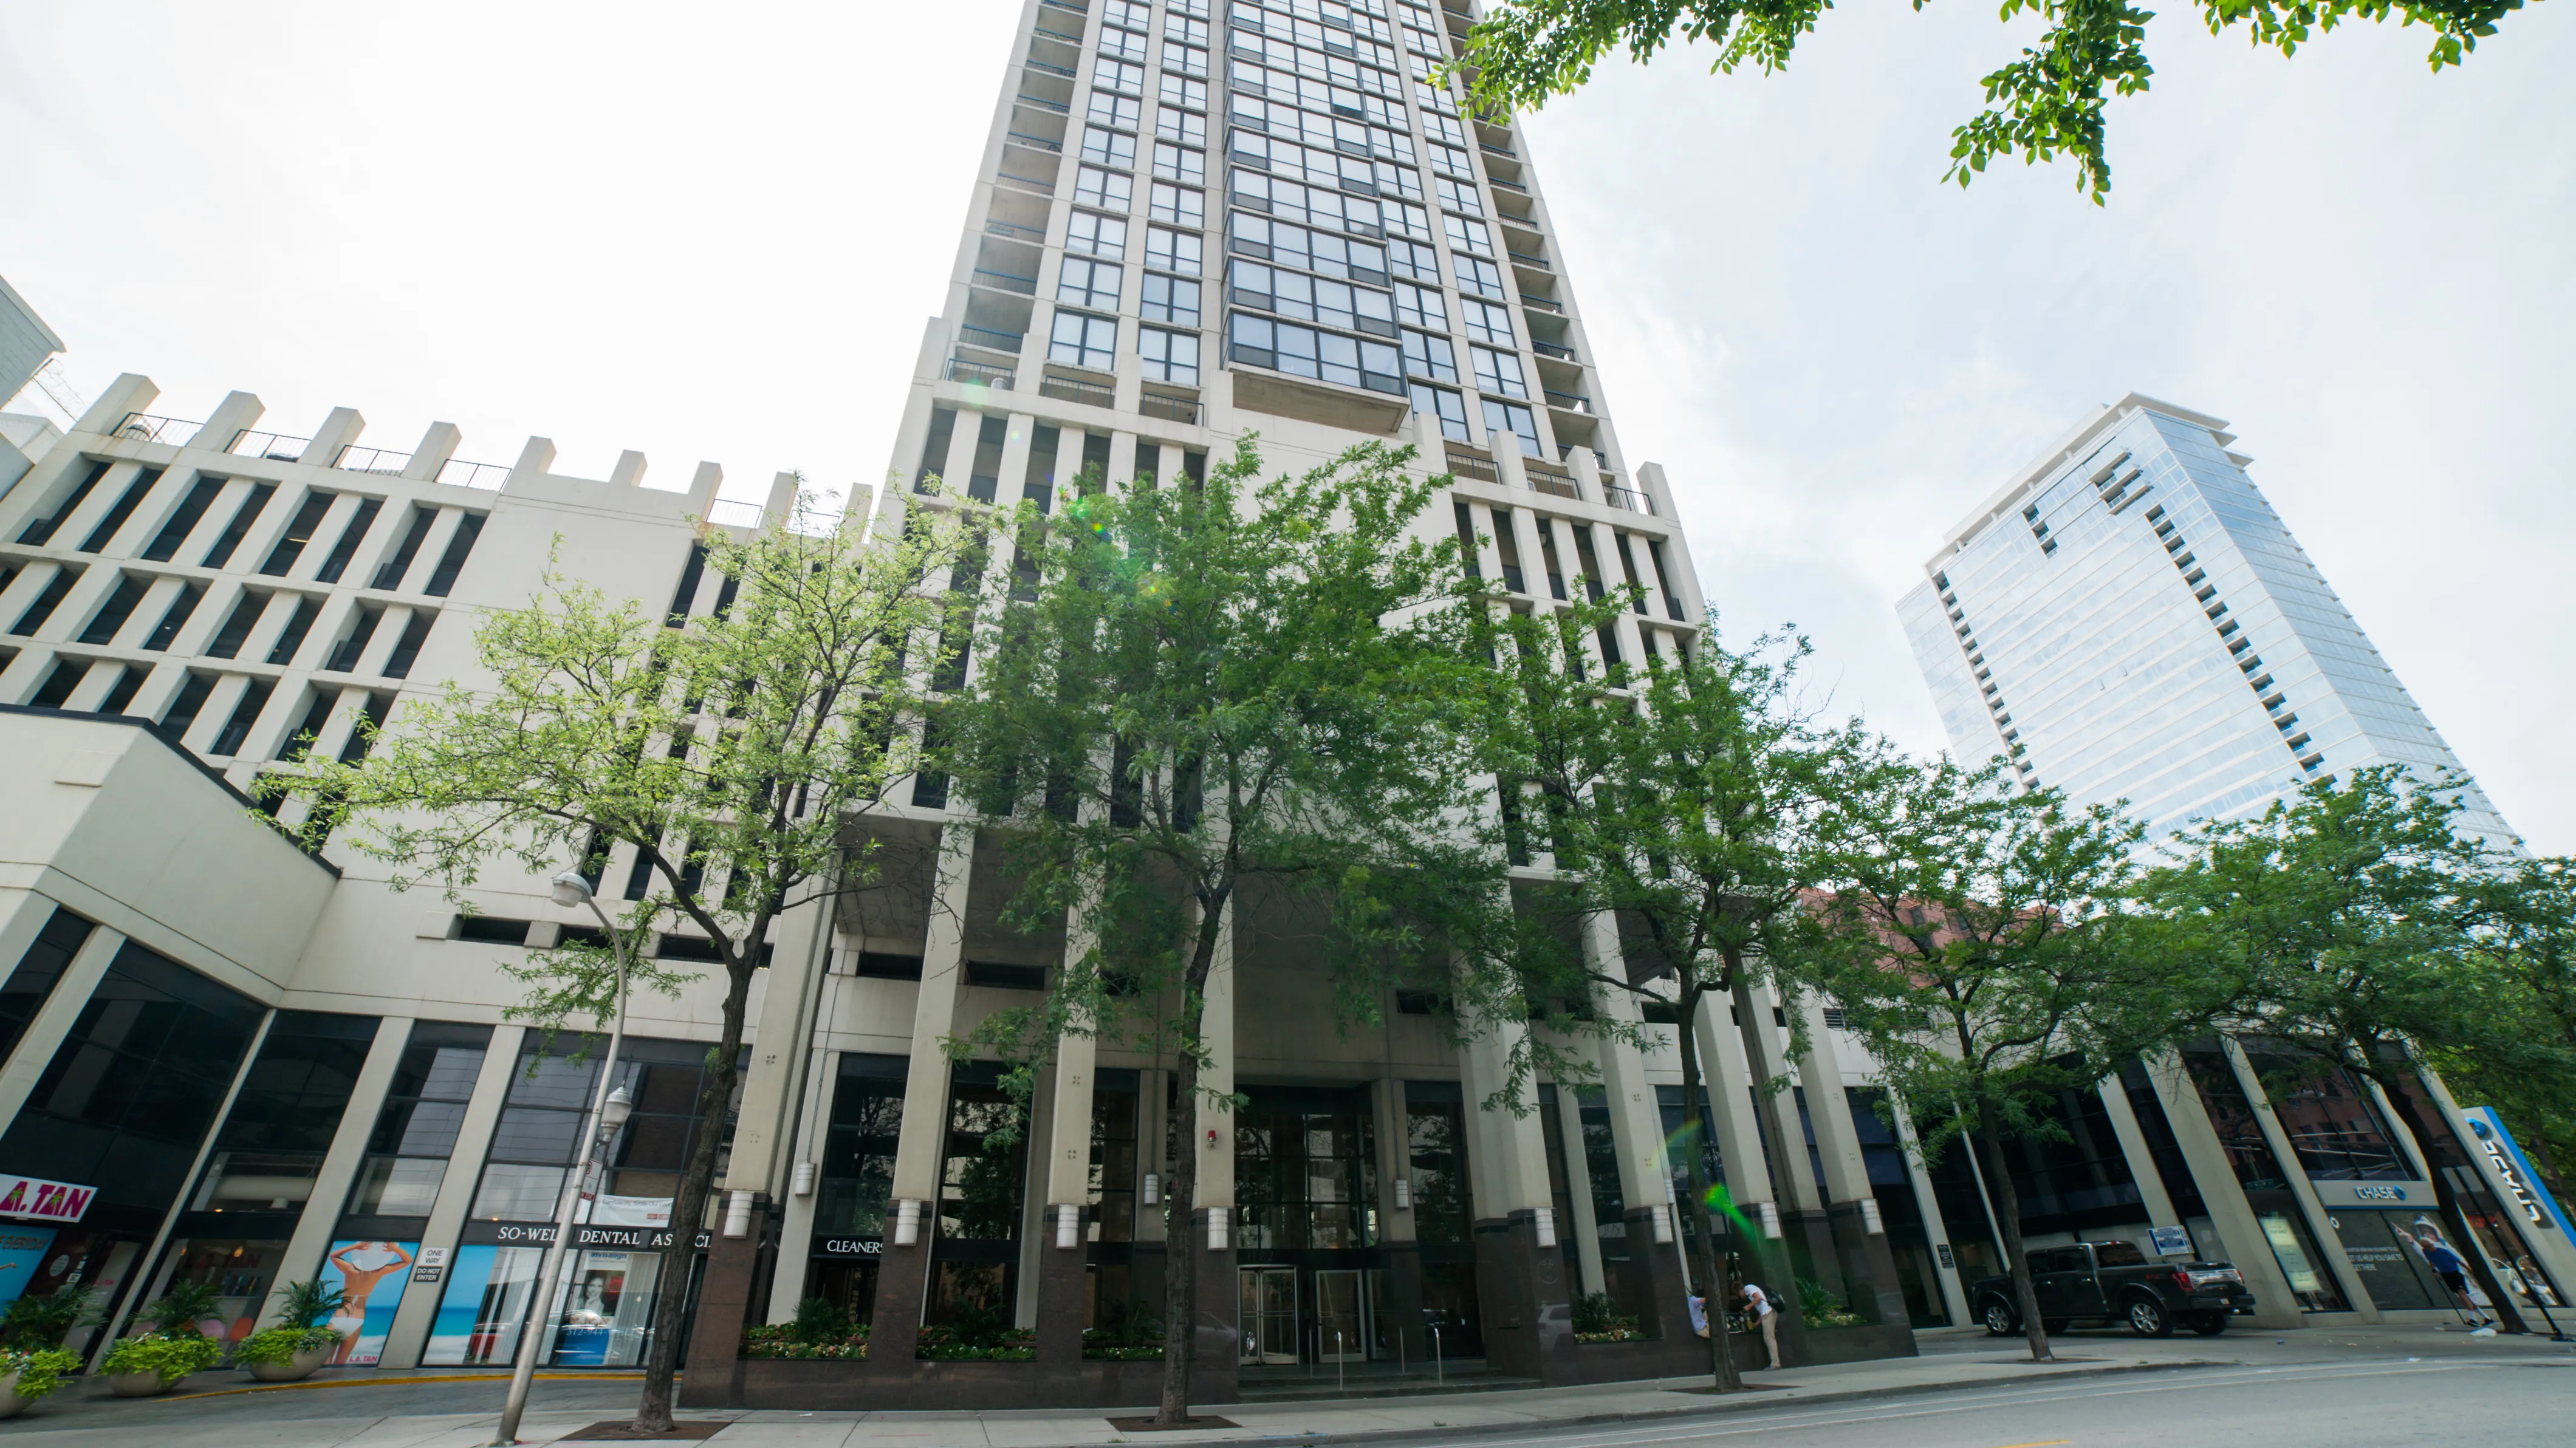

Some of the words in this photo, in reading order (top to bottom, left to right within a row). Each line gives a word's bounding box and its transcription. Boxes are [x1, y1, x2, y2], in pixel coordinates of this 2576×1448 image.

[29, 1184, 91, 1218] TAN
[2354, 1186, 2398, 1200] CHASE
[498, 1227, 557, 1241] SO-WEL
[579, 1231, 640, 1245] DENTAL
[651, 1233, 711, 1248] ASCI
